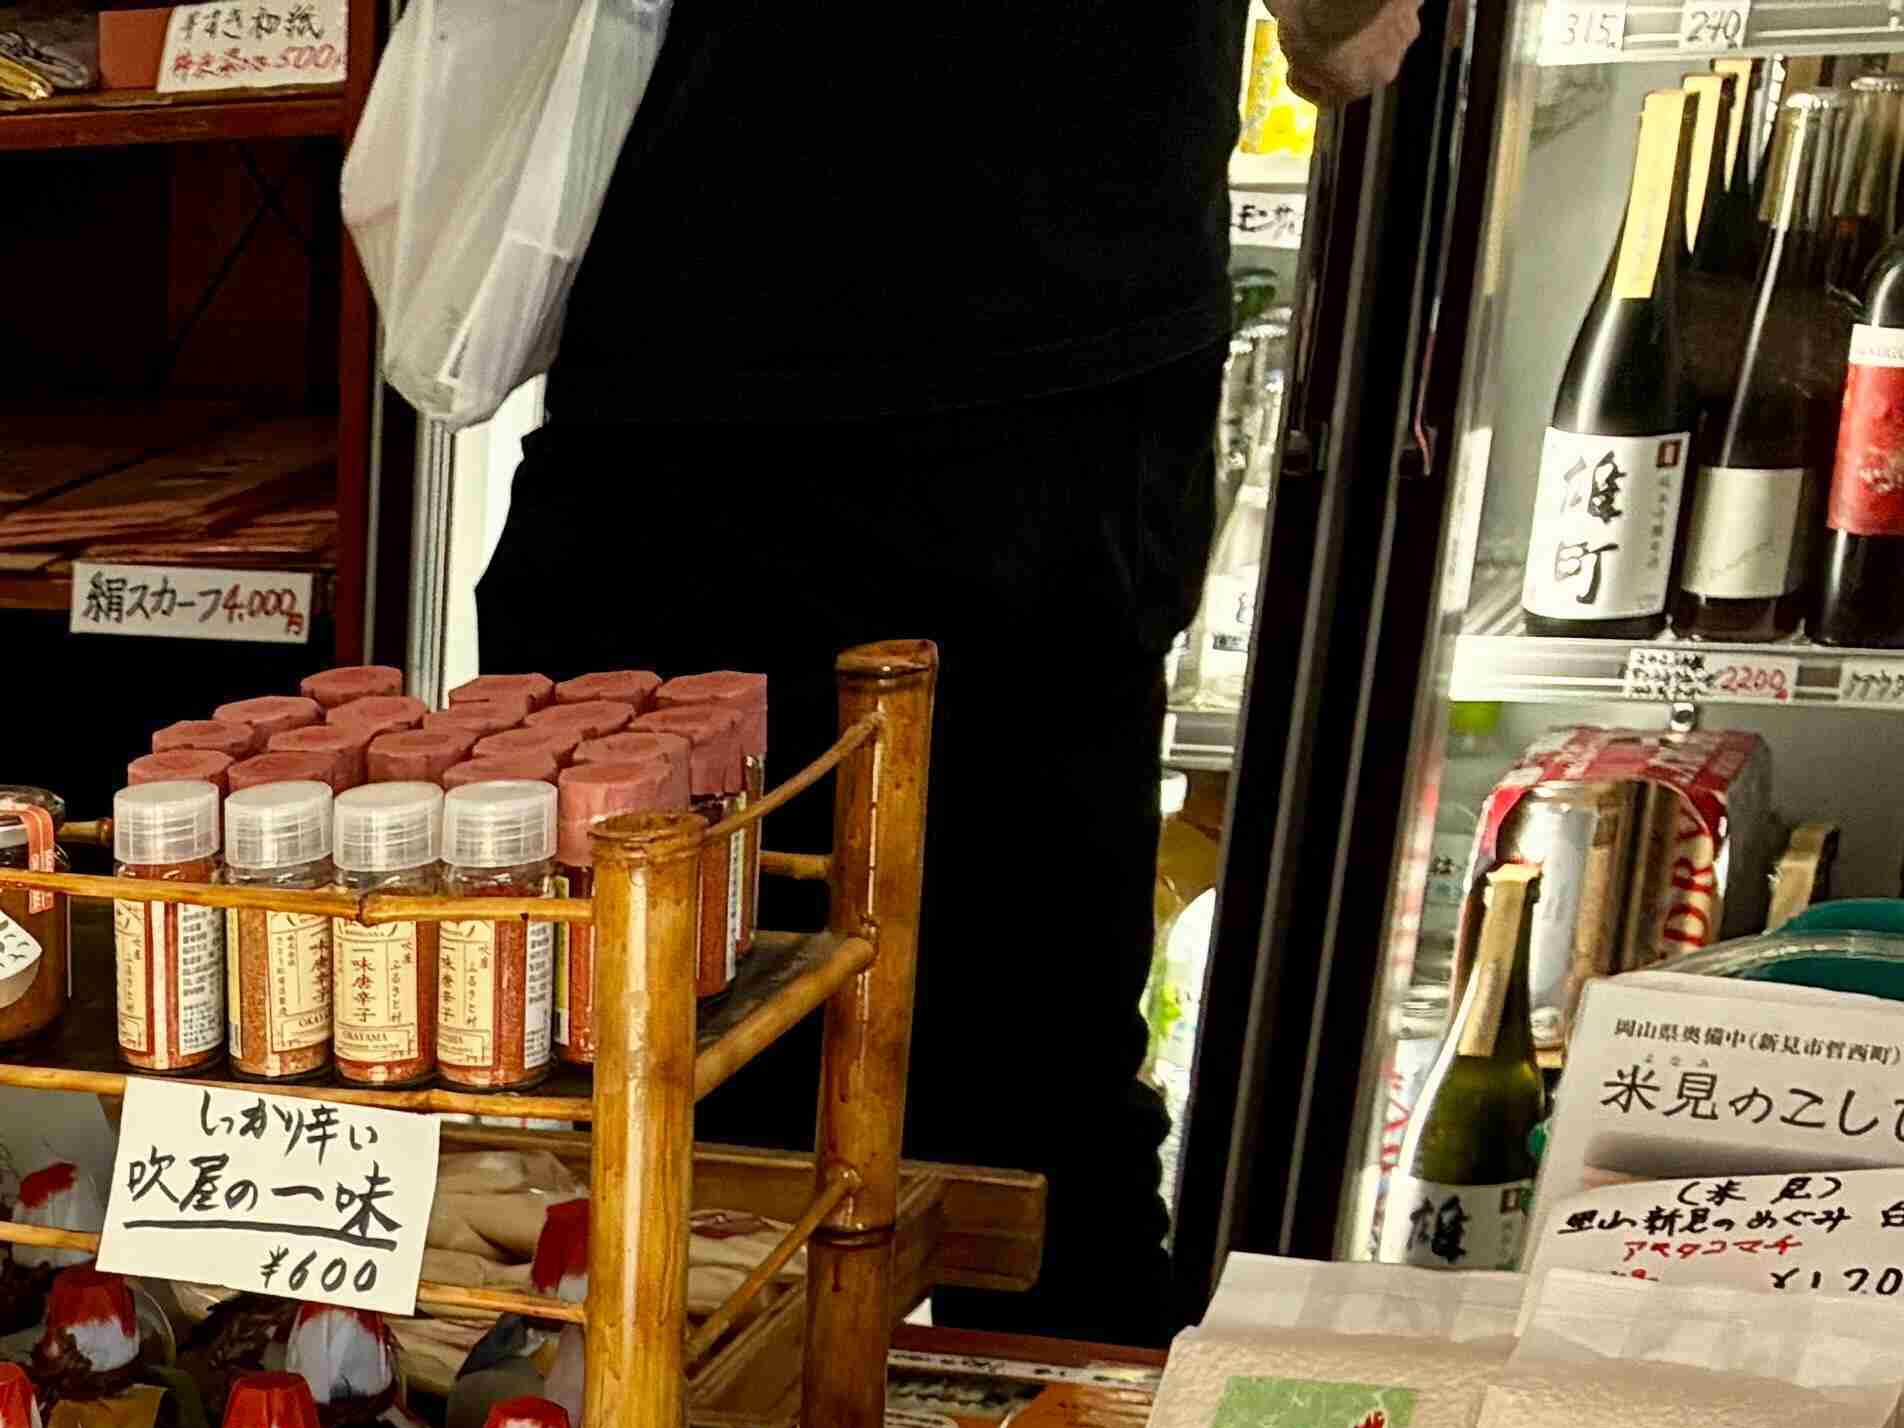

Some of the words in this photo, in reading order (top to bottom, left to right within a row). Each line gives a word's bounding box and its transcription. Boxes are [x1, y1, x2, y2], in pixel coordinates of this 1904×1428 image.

[127, 1146, 403, 1241] 吹屋の一味
